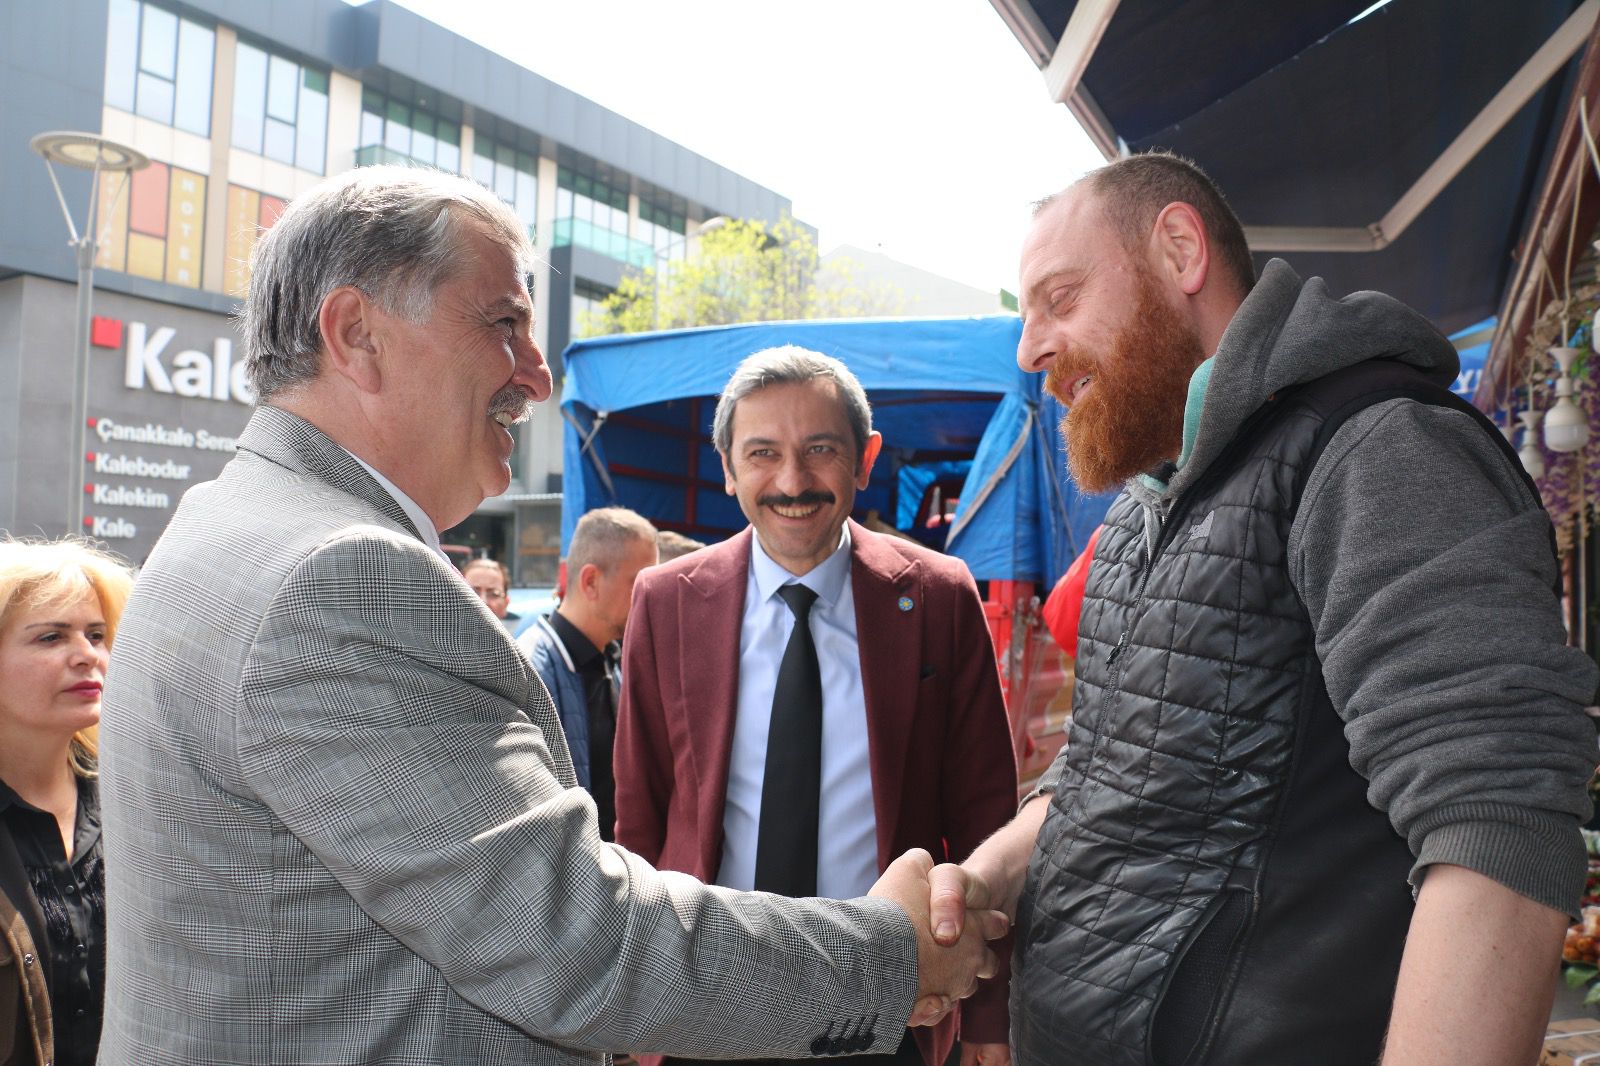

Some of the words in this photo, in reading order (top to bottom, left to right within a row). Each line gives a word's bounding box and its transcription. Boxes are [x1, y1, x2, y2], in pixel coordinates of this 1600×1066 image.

[96, 418, 194, 448] Çanakkale
[195, 429, 238, 452] Sera
[95, 452, 191, 479] Kalebodur
[93, 484, 168, 508] Kalekim
[92, 516, 136, 538] Kale
